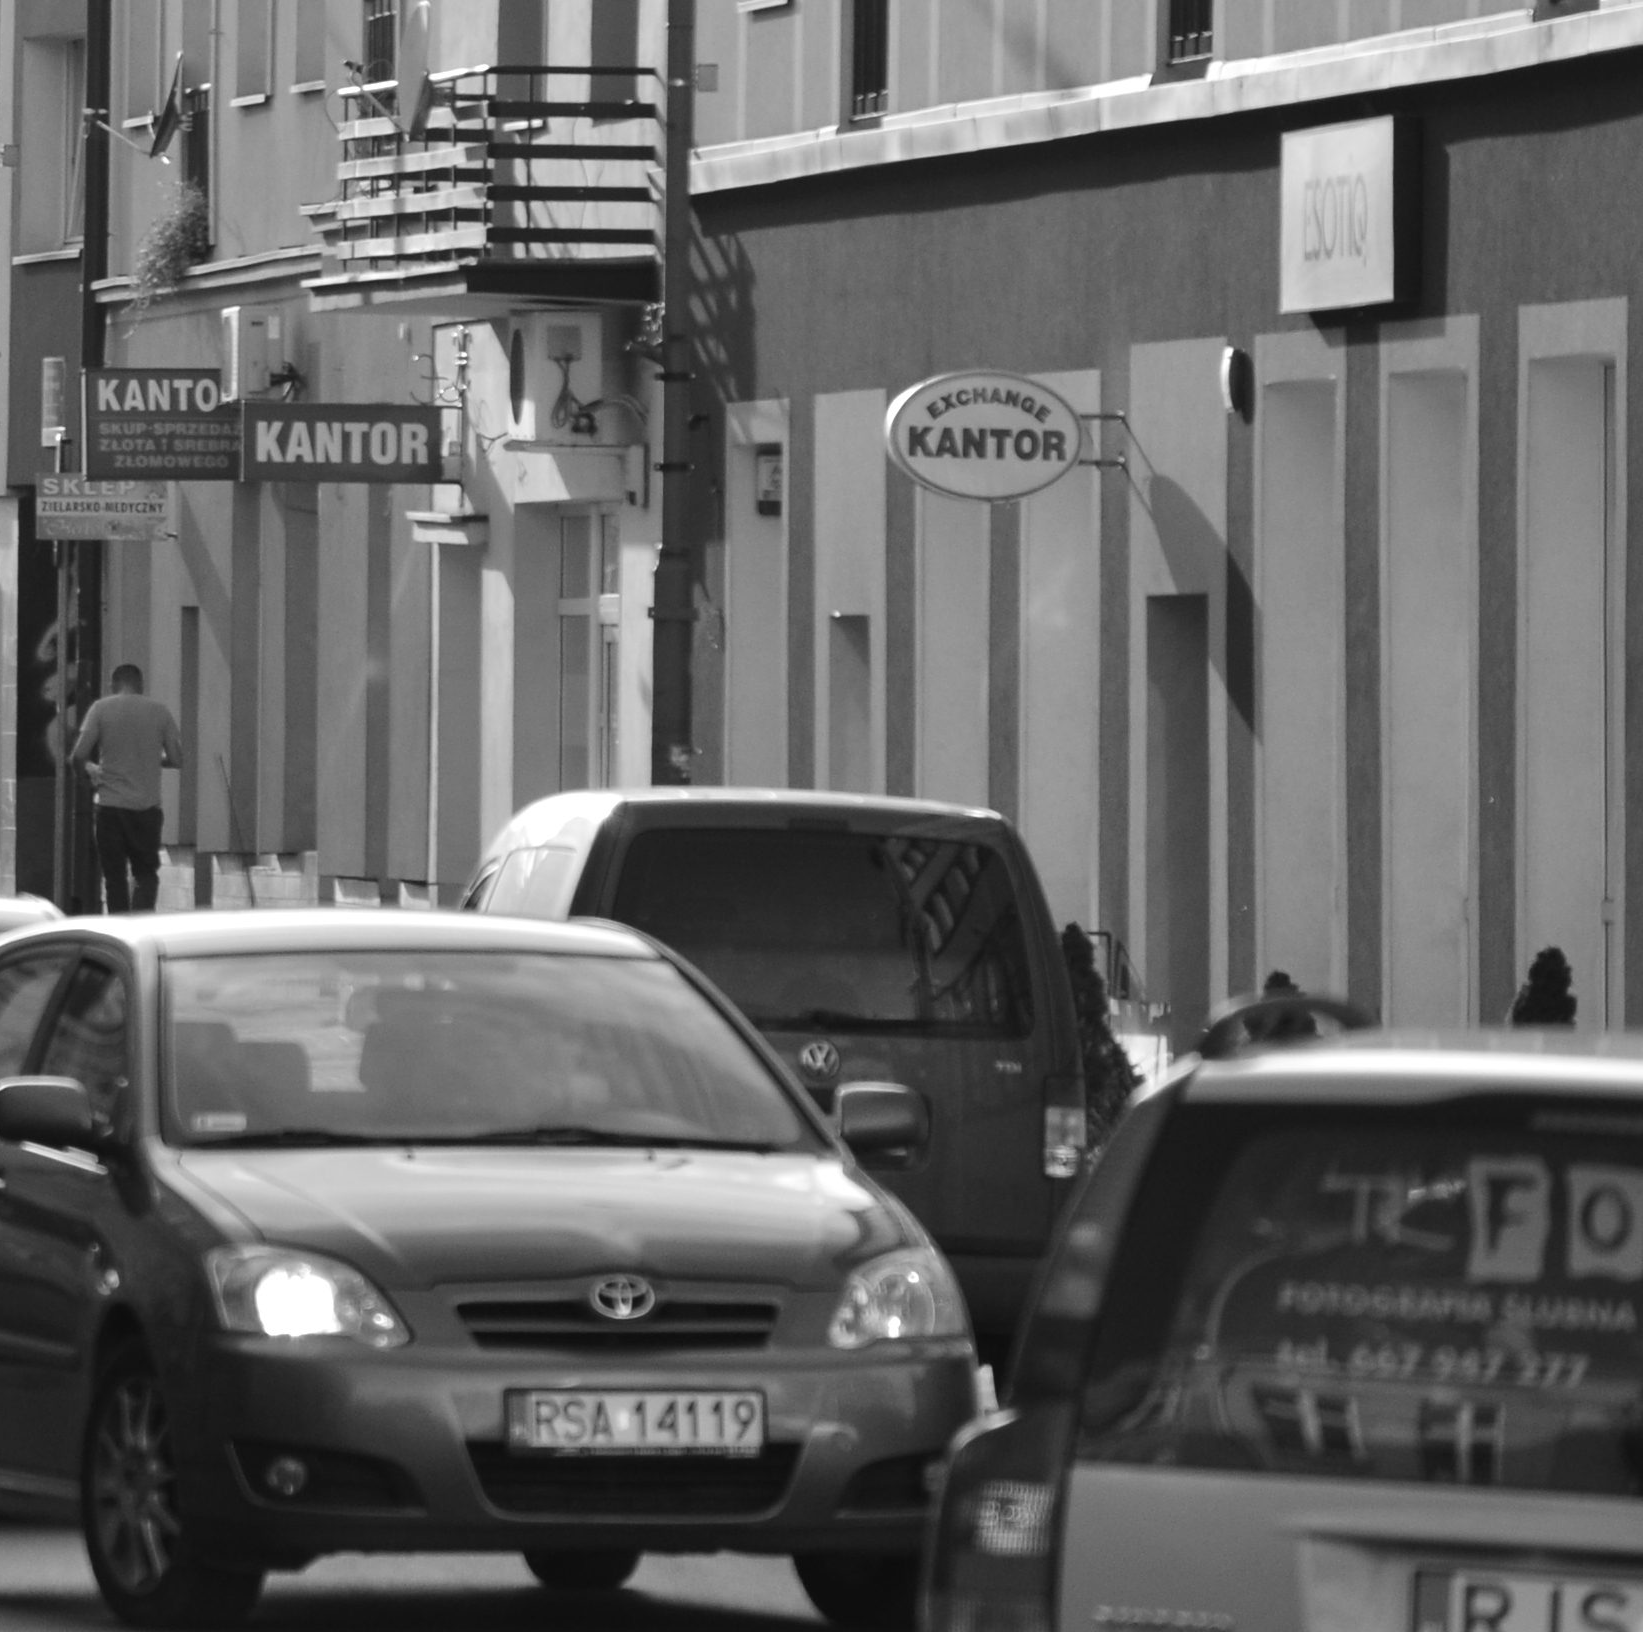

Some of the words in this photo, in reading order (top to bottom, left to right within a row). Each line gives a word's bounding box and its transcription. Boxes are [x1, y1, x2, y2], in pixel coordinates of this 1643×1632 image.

[97, 378, 219, 412] KANTO
[926, 387, 1052, 423] EXCHANGE
[99, 438, 156, 452] ZŁOTA
[255, 420, 429, 466] KANTOR
[908, 426, 1066, 461] KANTOR
[113, 454, 229, 468] ZŁOMOWEGO
[42, 478, 135, 495] SKLEP
[535, 1400, 615, 1441] RSA
[634, 1400, 756, 1441] 14119
